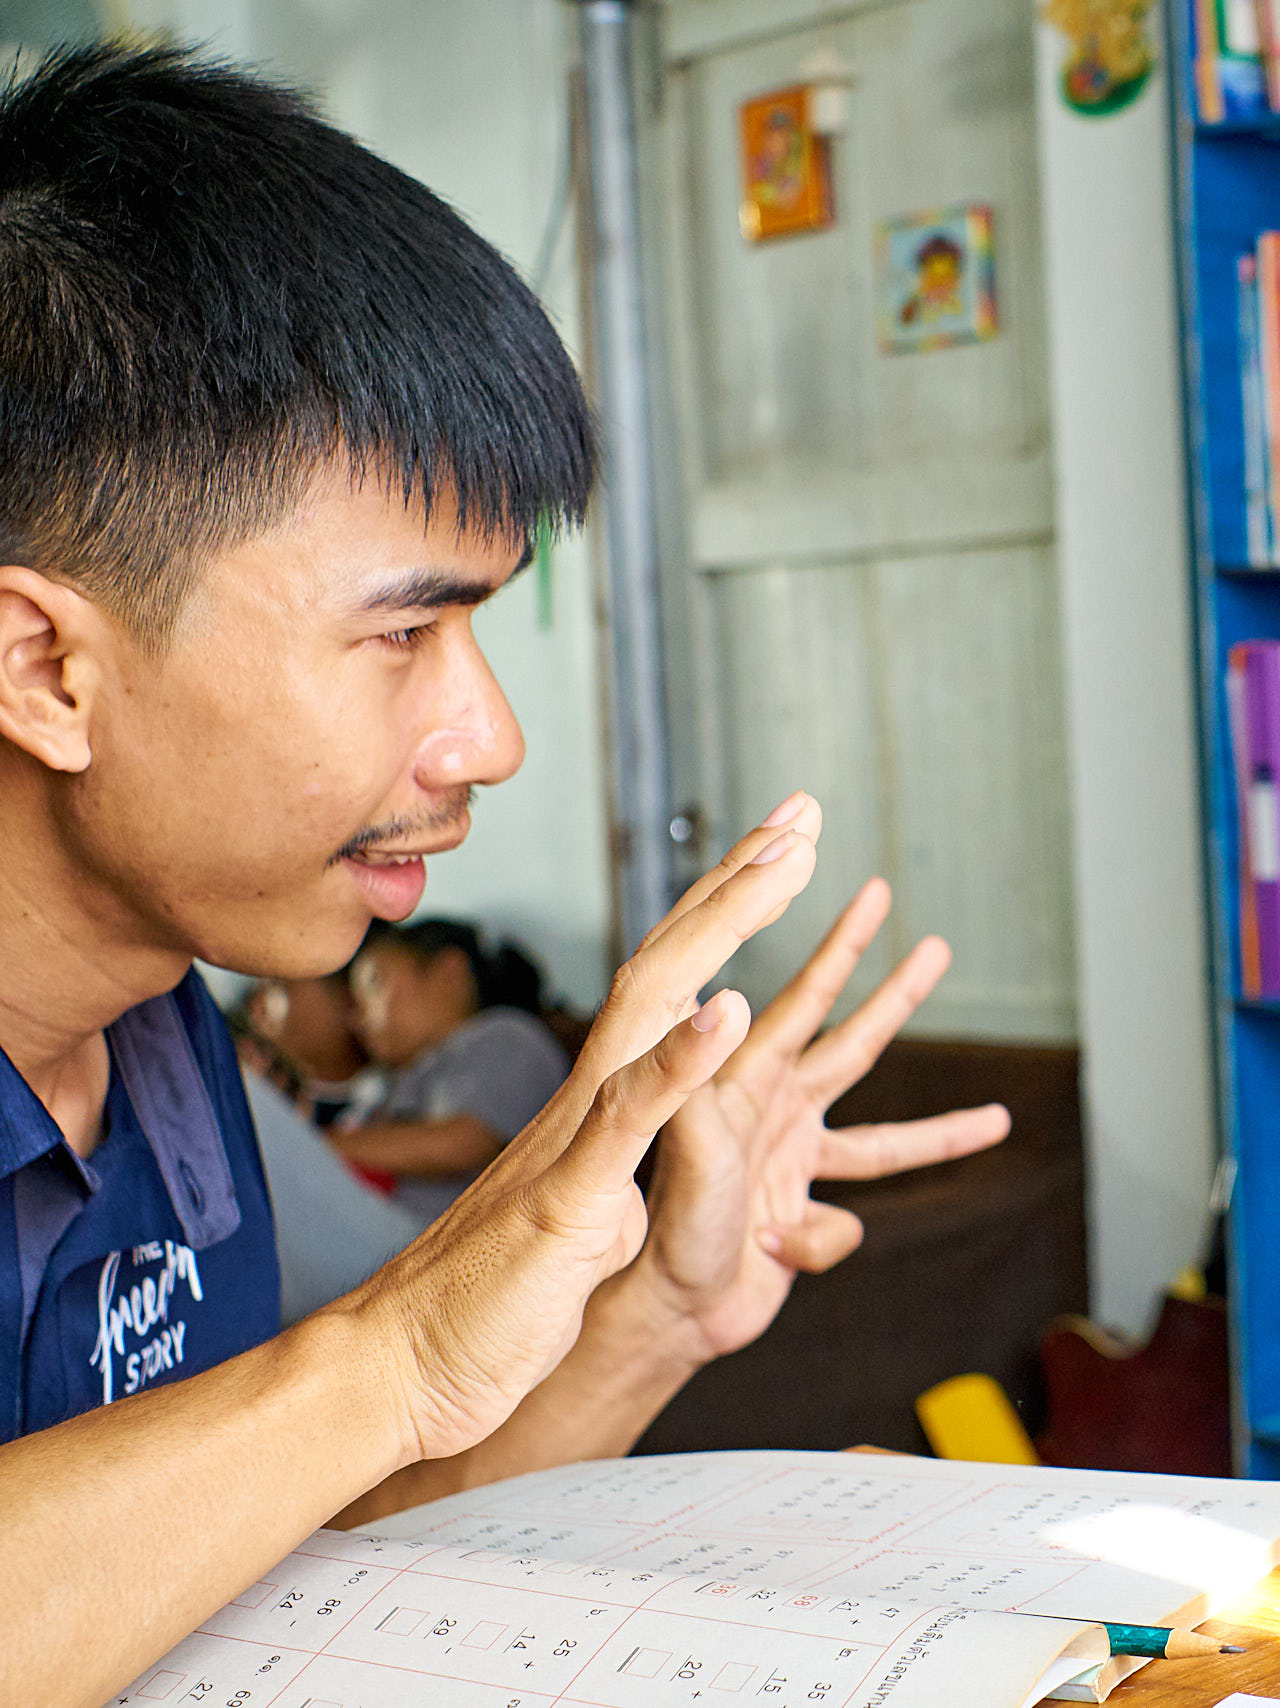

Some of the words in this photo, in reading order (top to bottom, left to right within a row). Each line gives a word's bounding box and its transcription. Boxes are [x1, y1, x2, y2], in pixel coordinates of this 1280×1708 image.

[124, 1320, 187, 1394] STORY
[711, 1584, 736, 1595] 36
[752, 1588, 776, 1600] 32
[278, 1592, 304, 1609] 24
[316, 1598, 342, 1617] 86
[793, 1595, 819, 1607] 68
[837, 1600, 860, 1611] 21
[880, 1606, 900, 1618] 47
[433, 1618, 458, 1636] 29
[512, 1634, 536, 1651] 14
[552, 1638, 578, 1657] 25
[678, 1661, 703, 1679] 20
[189, 1682, 214, 1701] 27
[763, 1677, 788, 1693] 15
[807, 1682, 832, 1700] 35
[227, 1690, 252, 1708] 69
